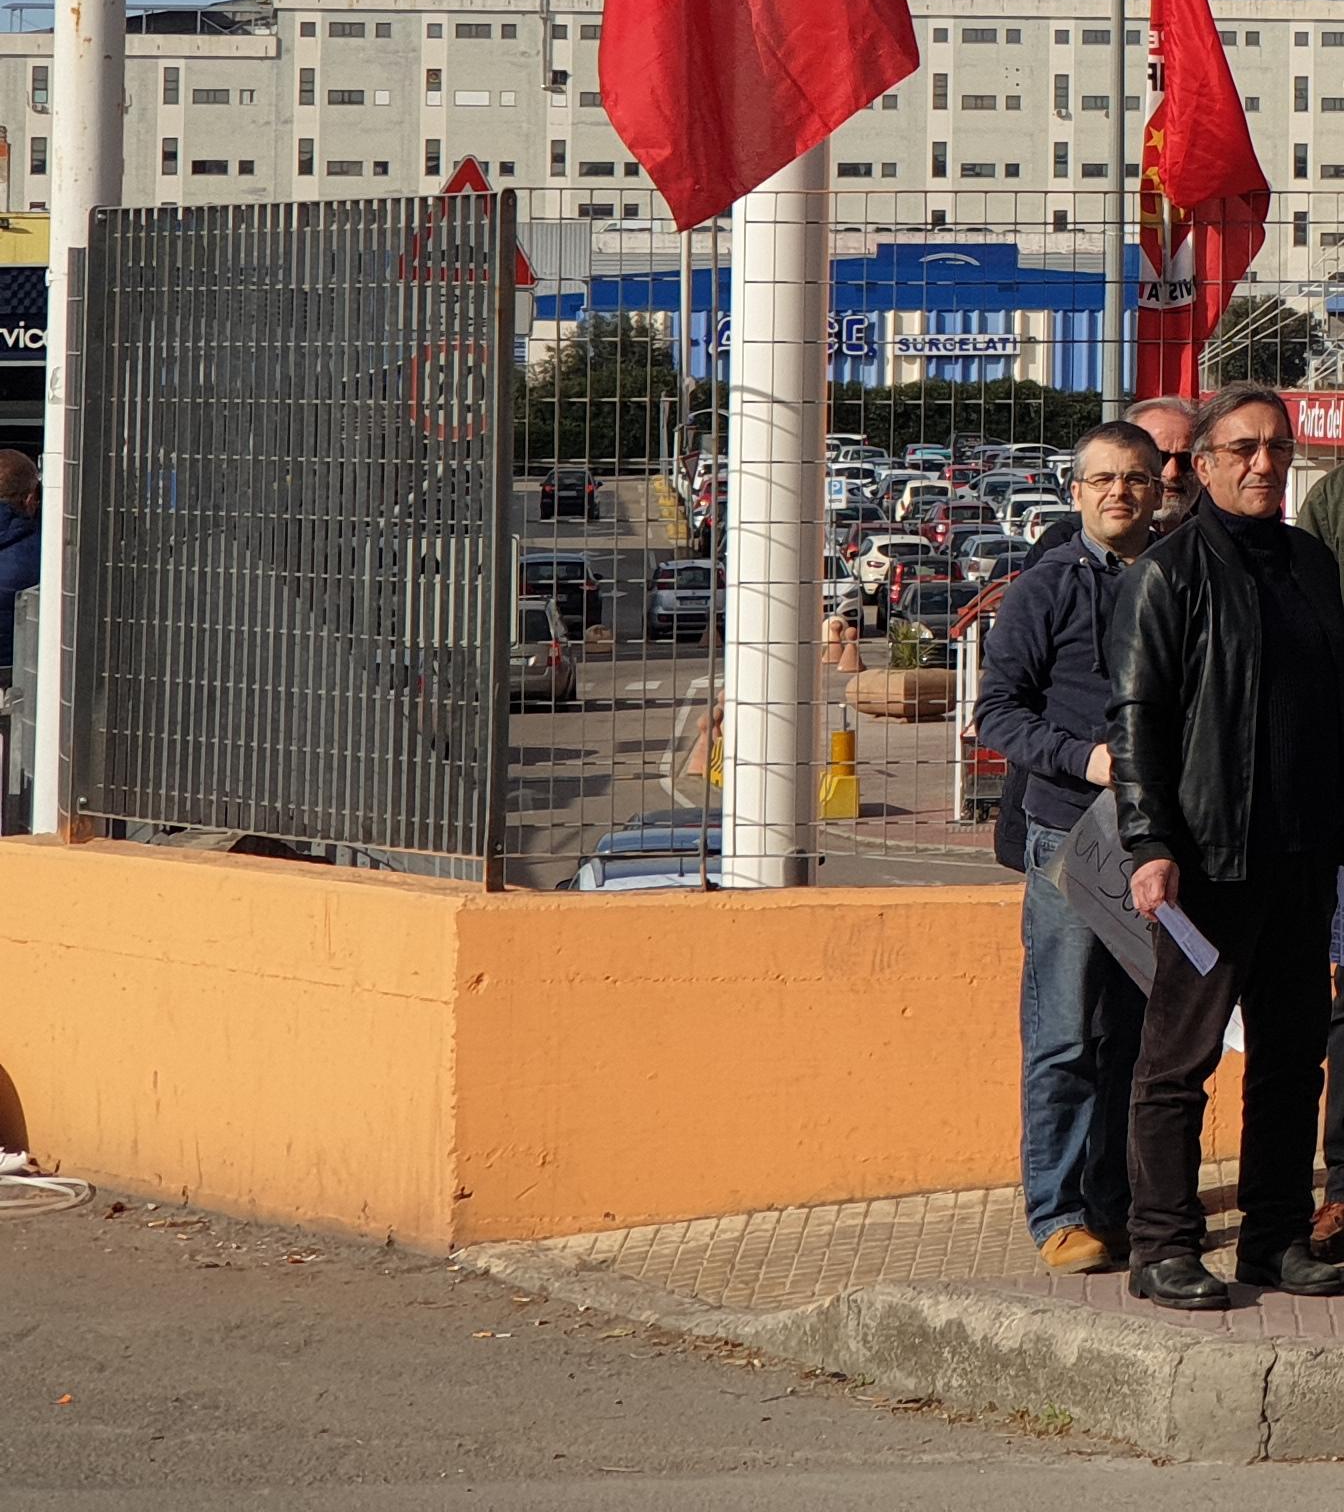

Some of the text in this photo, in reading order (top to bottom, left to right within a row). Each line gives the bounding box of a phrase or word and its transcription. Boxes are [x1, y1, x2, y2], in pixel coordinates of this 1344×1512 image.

[898, 337, 1018, 353] SURGELATI
[1298, 399, 1325, 438] Porta
[1327, 399, 1344, 439] del
